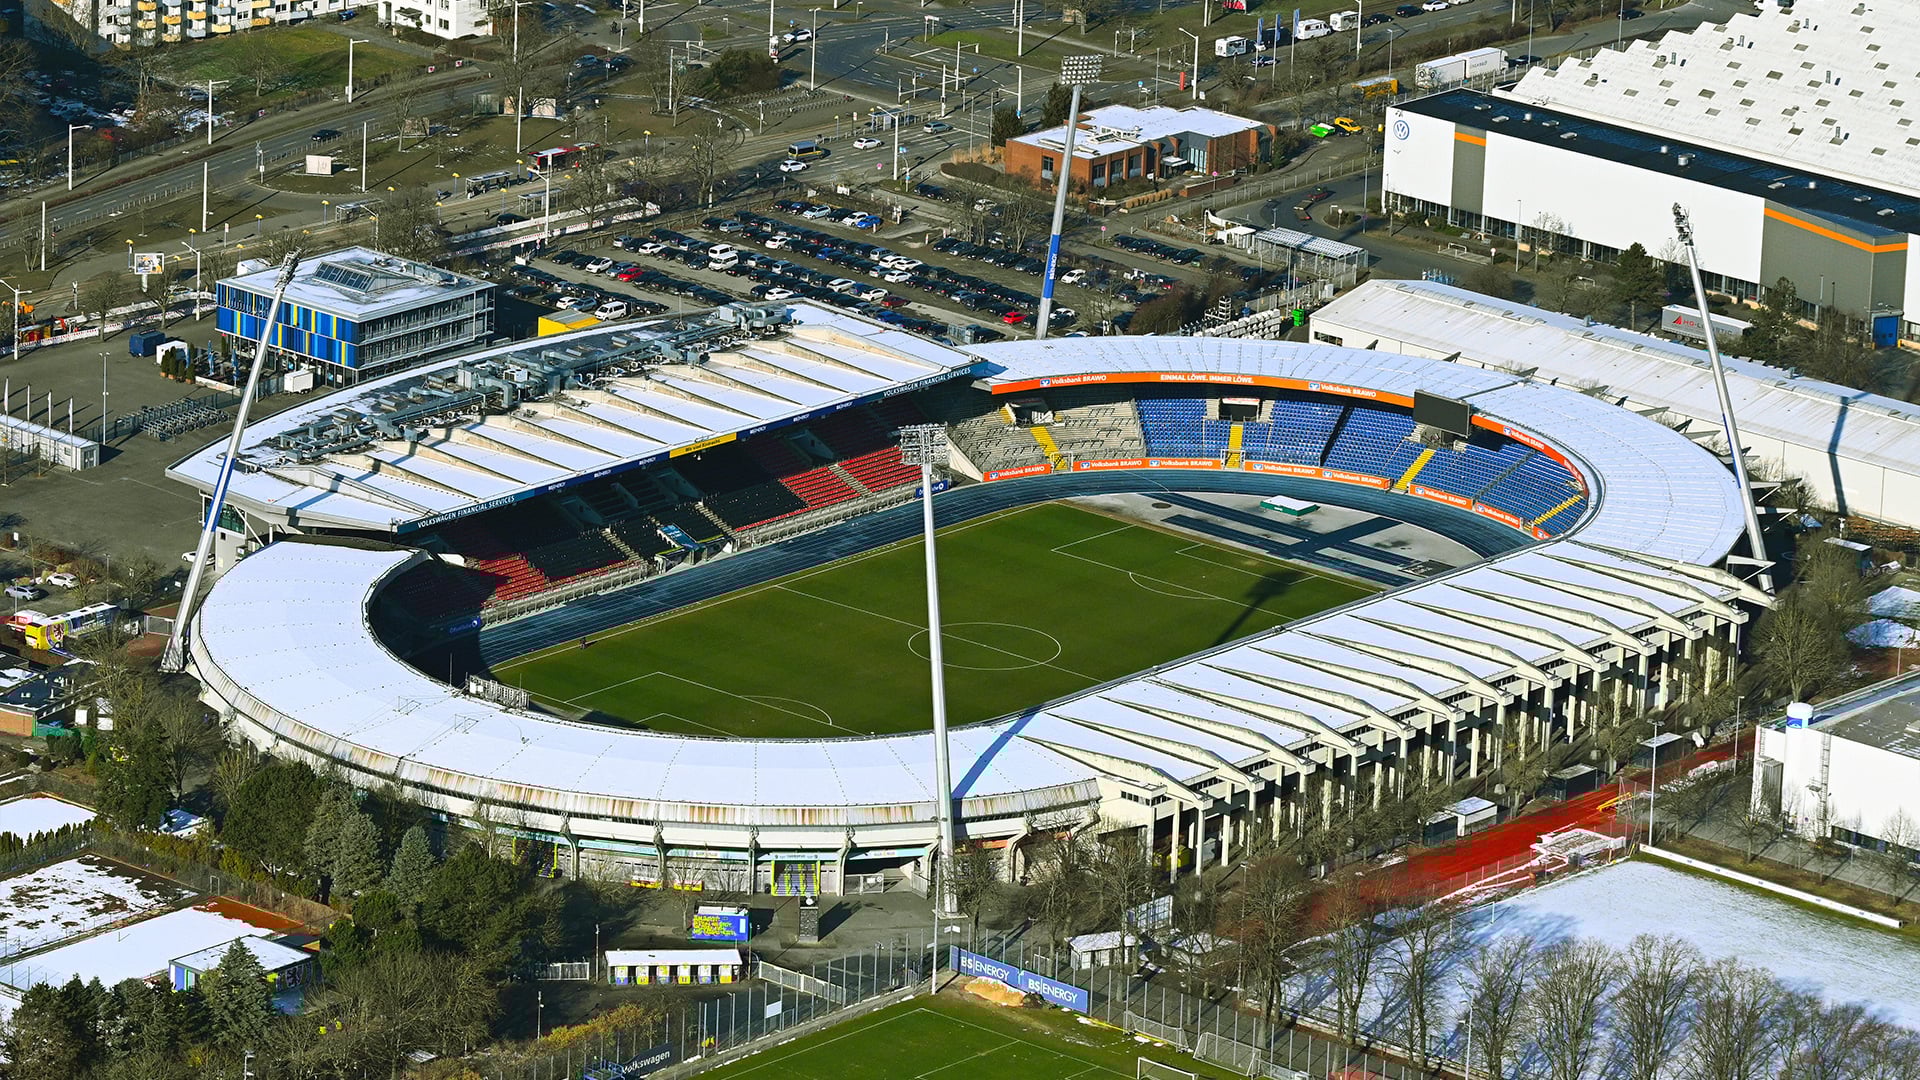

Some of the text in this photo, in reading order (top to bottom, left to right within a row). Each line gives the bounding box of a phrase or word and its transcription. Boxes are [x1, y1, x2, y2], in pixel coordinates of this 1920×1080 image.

[883, 367, 971, 397] VOLKSWAGEN FINANCIAL SERVICES
[1051, 377, 1081, 385] Volksbank
[1321, 383, 1377, 398] Volksbank BRAWO
[999, 465, 1045, 477] Volksbank BRAWO
[1264, 464, 1316, 475] Volksbank BRAWO
[1333, 472, 1382, 485] Volksbank BRAWO
[417, 495, 515, 528] VOLKSWAGEN FINANCIAL SERVICES
[622, 1050, 670, 1074] Volkswagen
